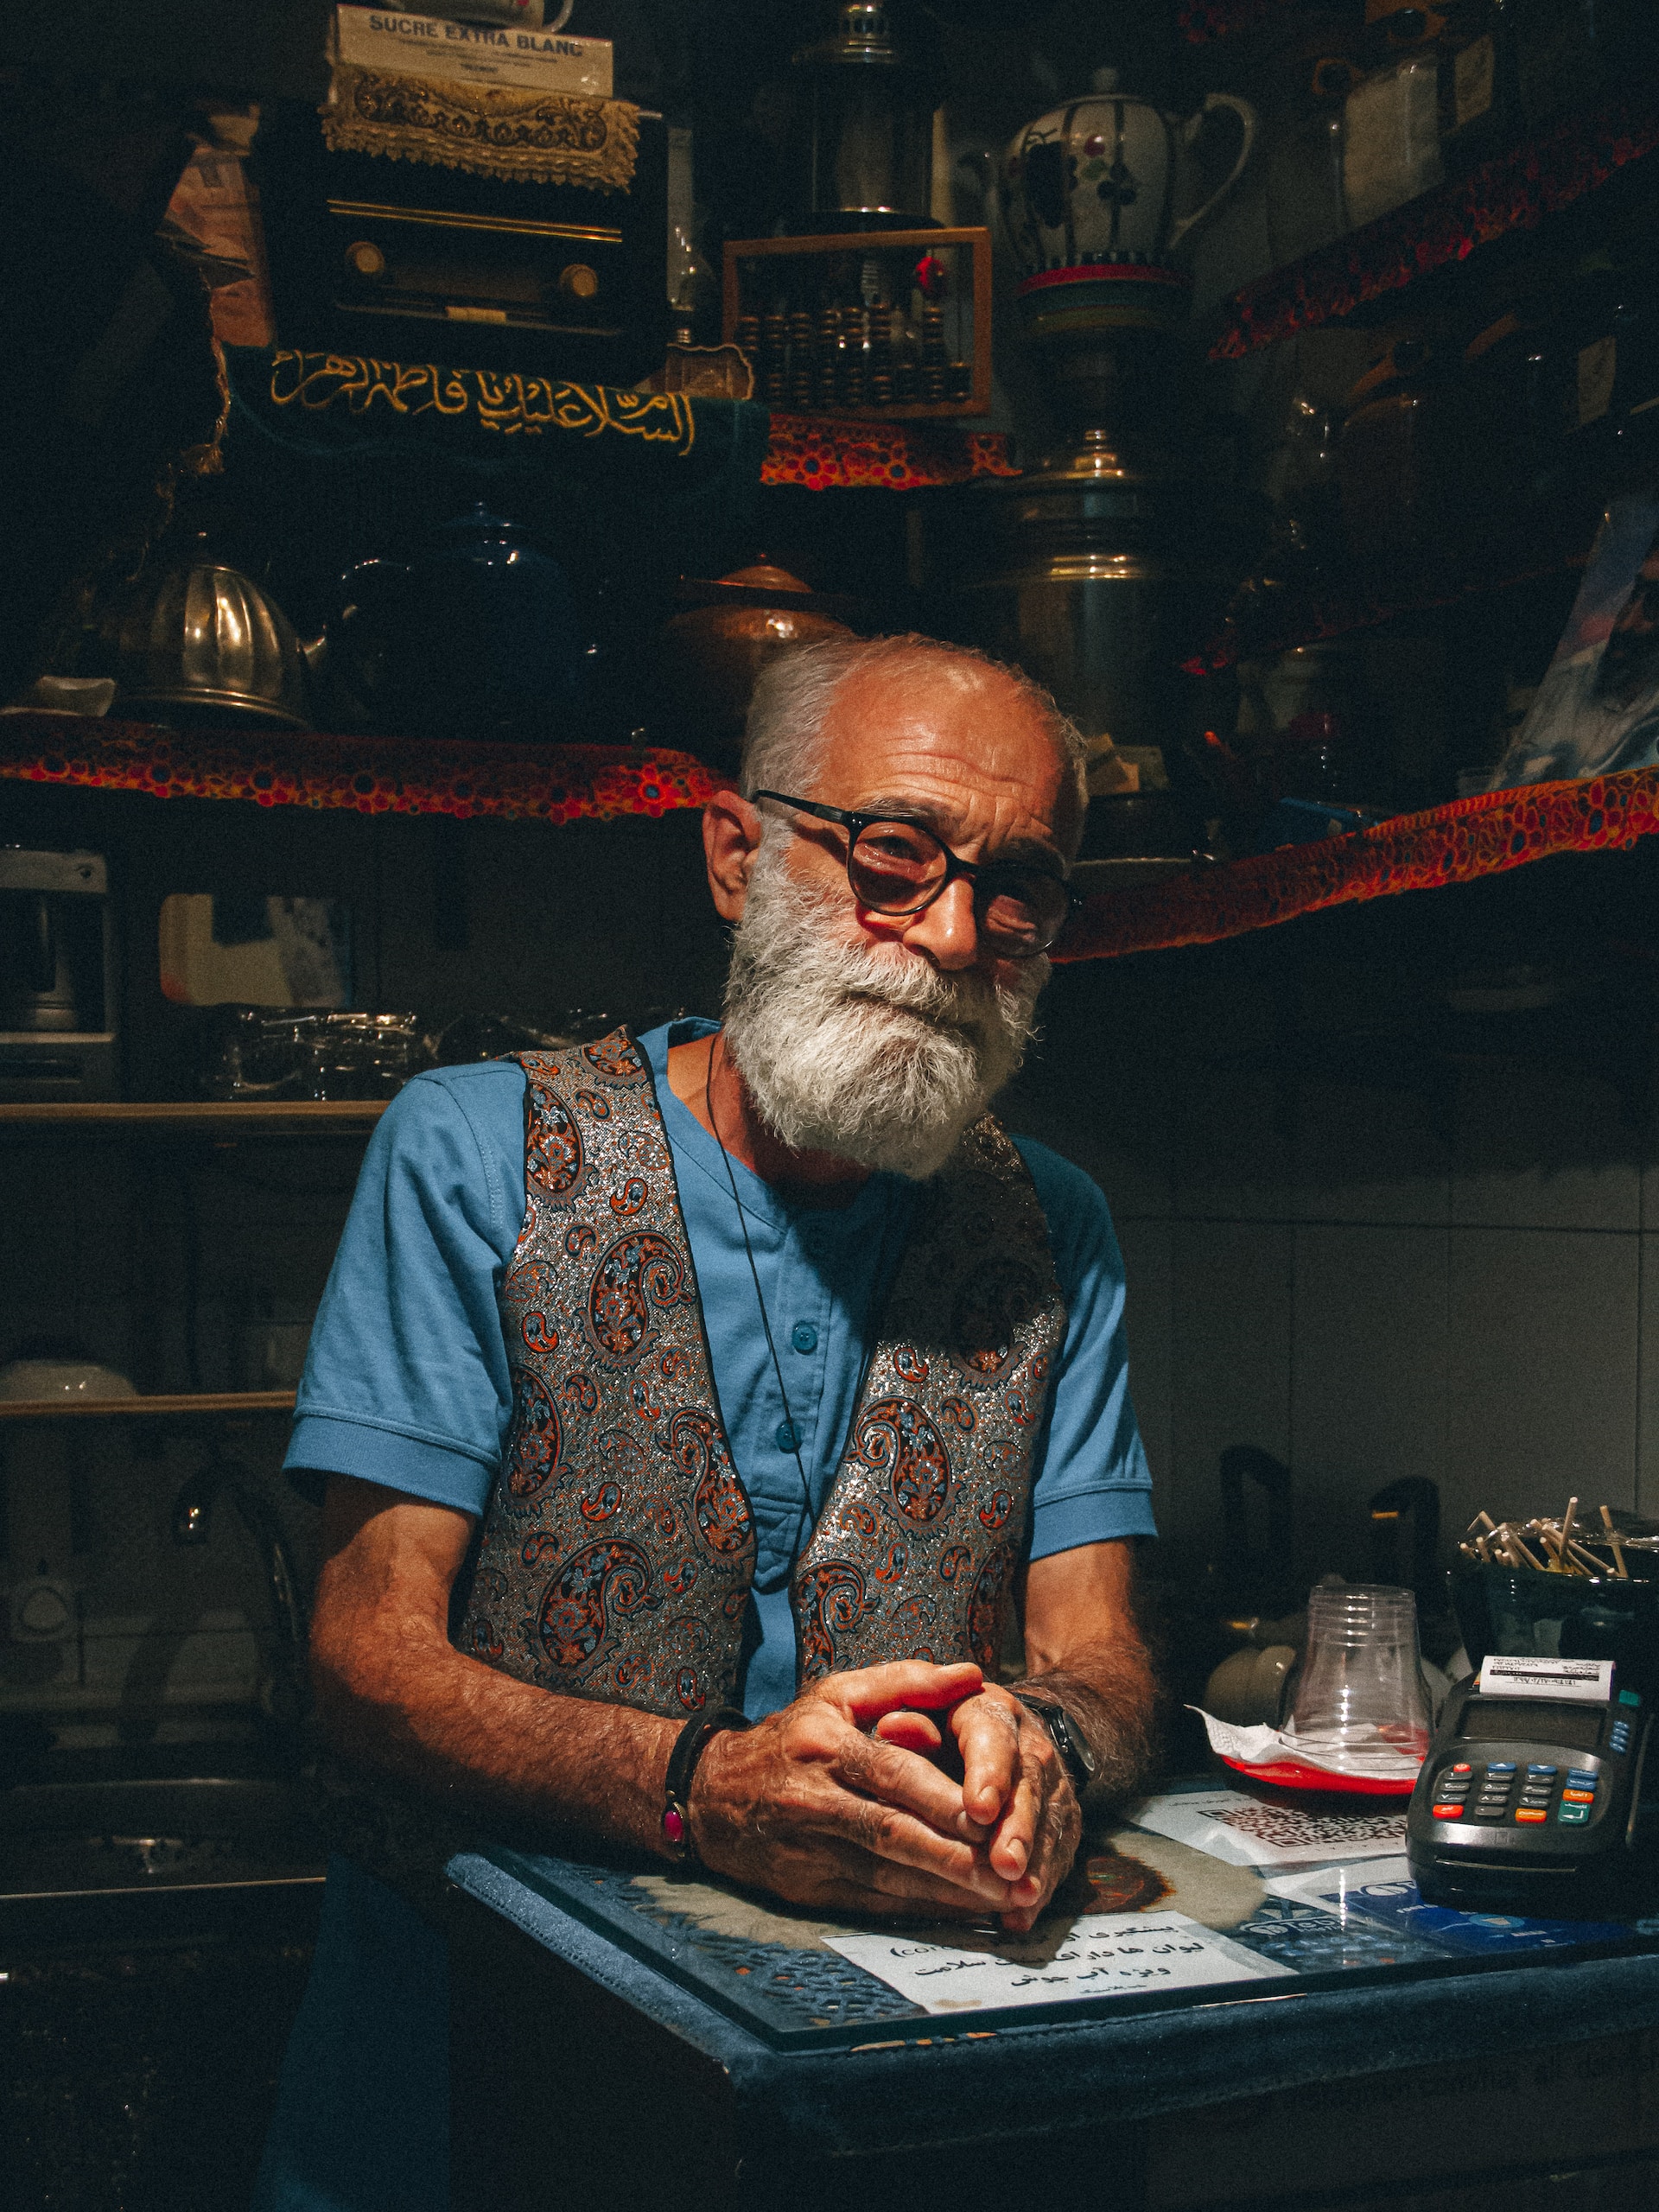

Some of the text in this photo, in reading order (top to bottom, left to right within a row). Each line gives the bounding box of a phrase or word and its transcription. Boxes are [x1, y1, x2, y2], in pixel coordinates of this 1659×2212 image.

[369, 15, 438, 39] SUCRE
[445, 24, 510, 48] EXTRA
[517, 35, 582, 57] BLANC
[1088, 1925, 1179, 1939] پیشگیری
[1054, 1950, 1115, 1961] دارای
[1152, 1942, 1205, 1955] لیوان
[914, 1959, 986, 1975] سلامت
[1011, 1967, 1171, 1986] ویژه آب جوش
